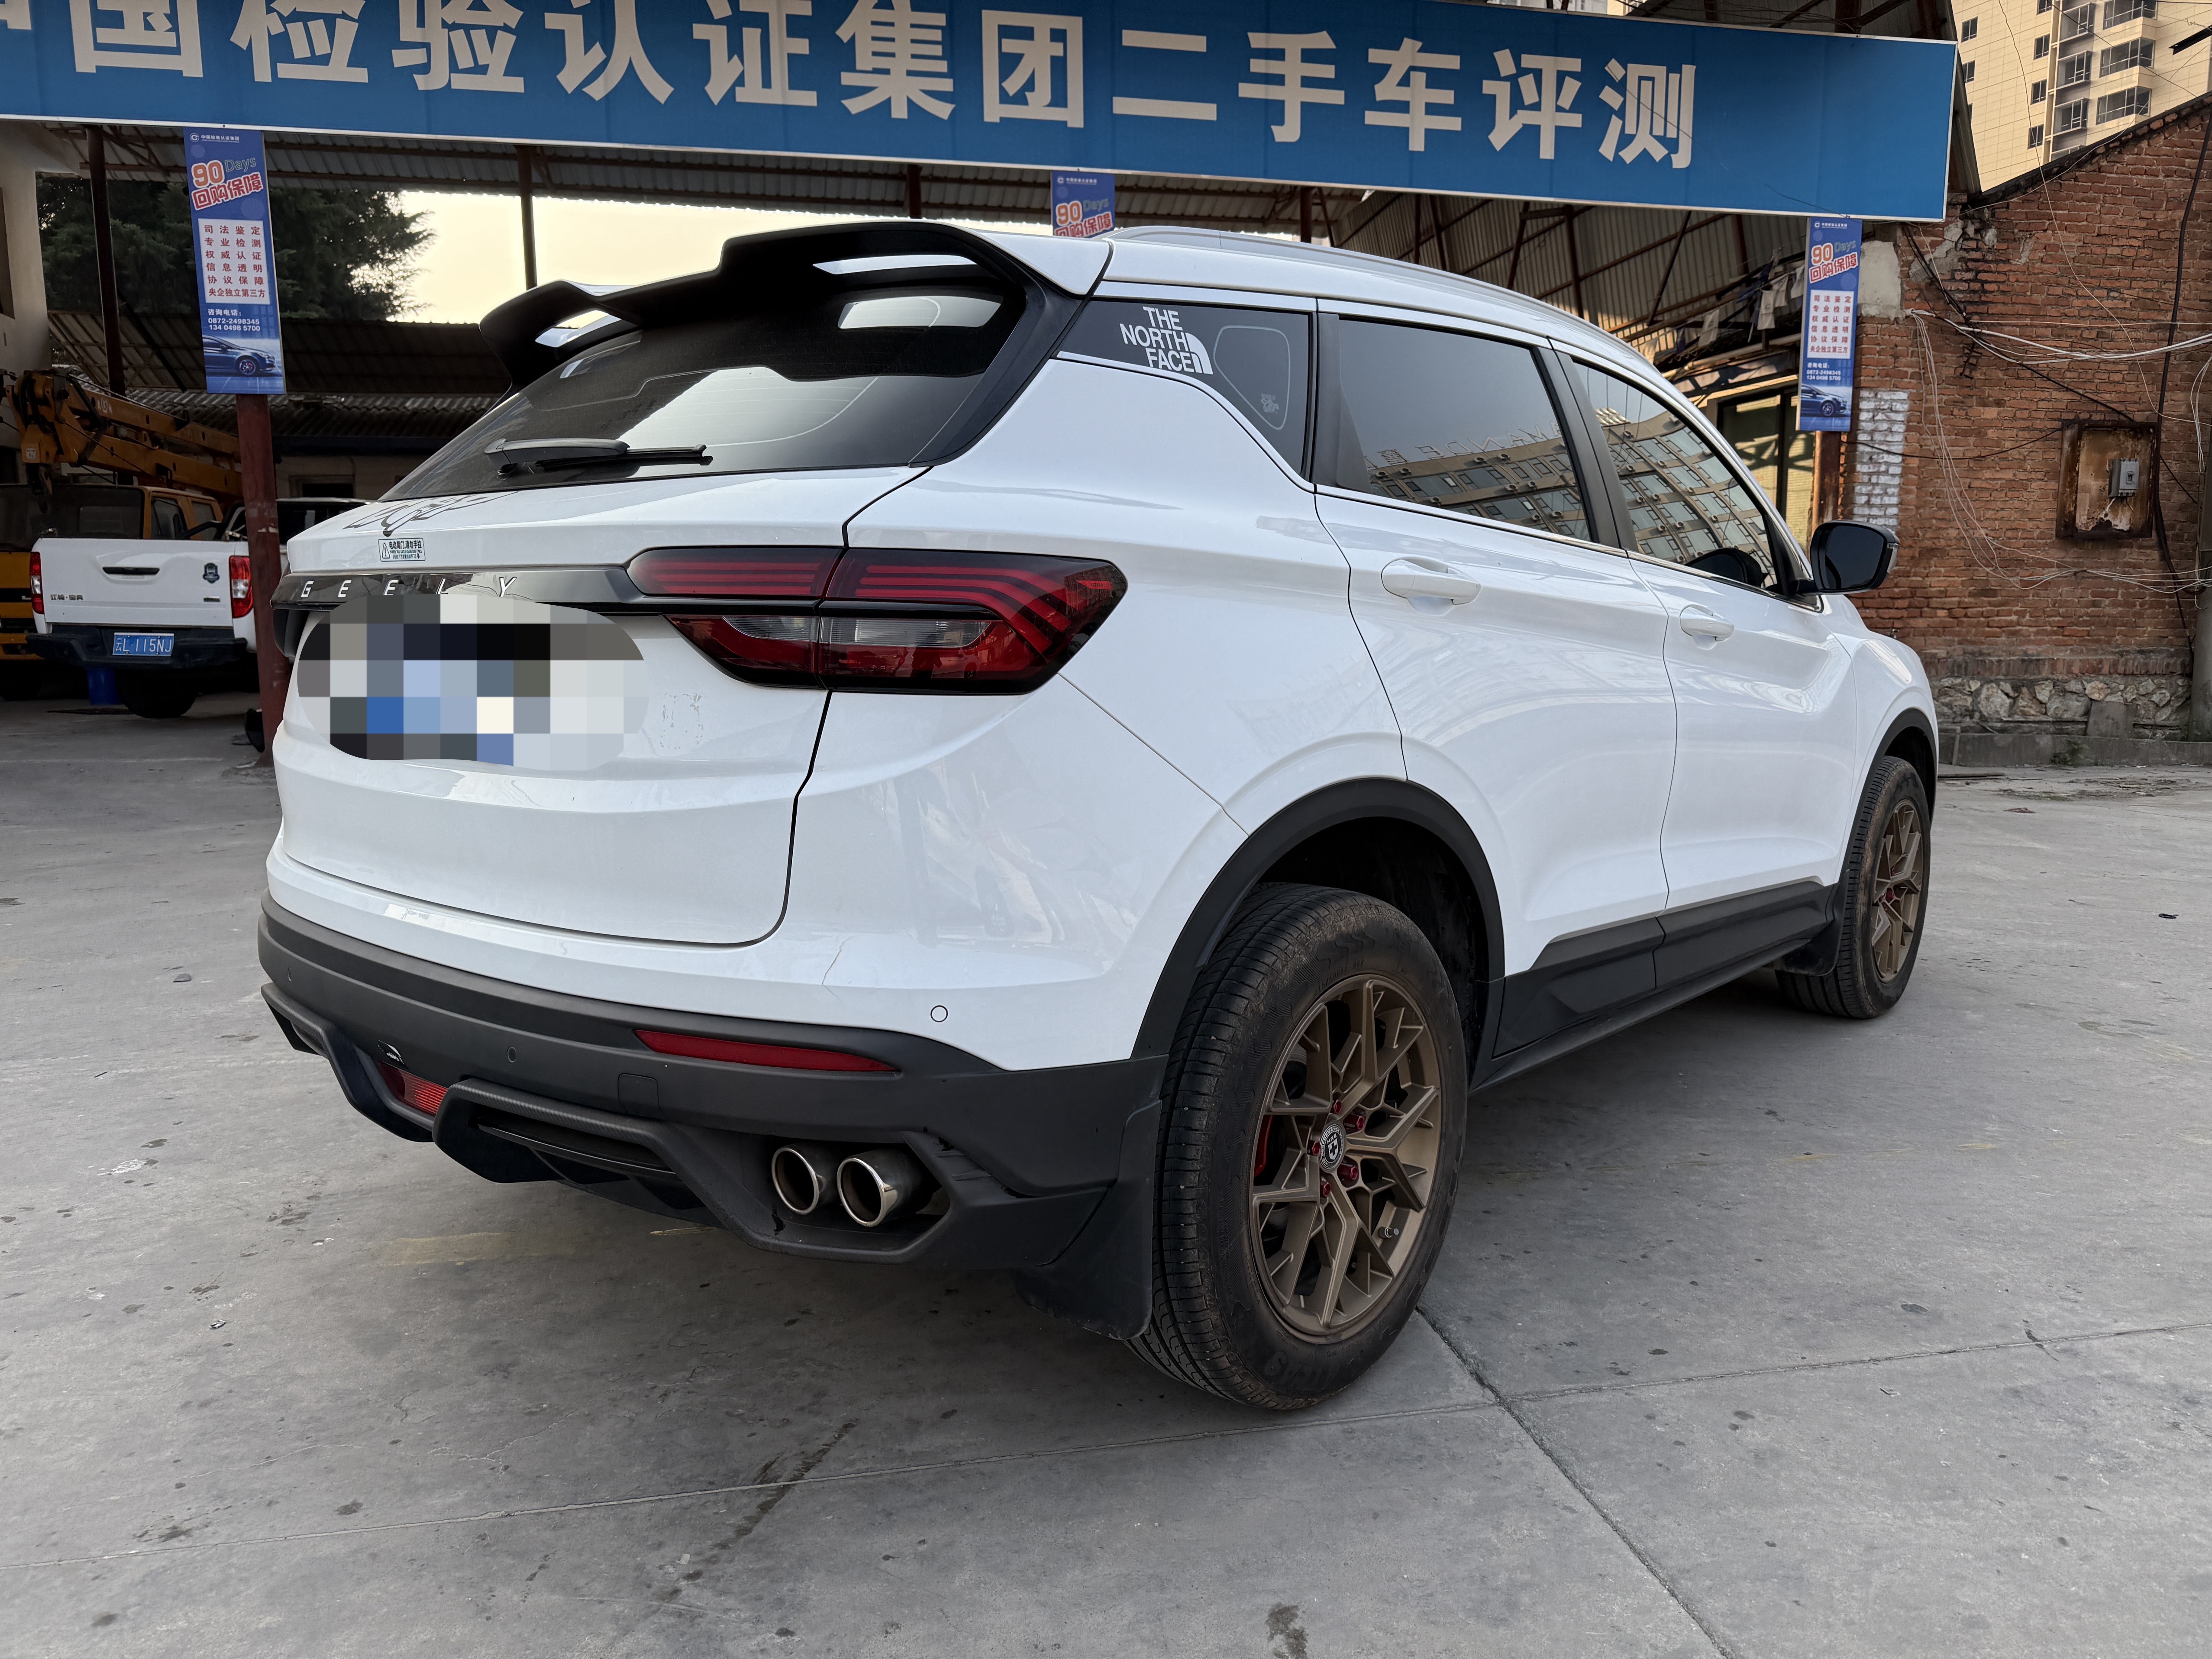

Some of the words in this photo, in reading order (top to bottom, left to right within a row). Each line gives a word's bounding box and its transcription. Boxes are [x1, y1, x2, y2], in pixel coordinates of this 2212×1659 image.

[0, 0, 1696, 168] 国检验认证集团二手车评测
[192, 160, 224, 187] 90
[225, 158, 256, 172] Days
[191, 172, 263, 210] 回购保障
[1056, 200, 1082, 226] 90
[1082, 198, 1109, 212] Days
[204, 225, 261, 235] 司法鉴定
[204, 237, 261, 248] 专业检测
[205, 250, 262, 260] 权威认证
[1811, 242, 1833, 265] 90
[1834, 240, 1856, 252] Days
[206, 262, 262, 272] 信息透明
[1808, 252, 1858, 284] 回购保障
[207, 275, 264, 285] 协议保障
[208, 287, 266, 298] 央企独立第三方
[1143, 306, 1183, 331] THE
[1119, 323, 1190, 352] NORTH
[1145, 348, 1194, 373] FACE
[300, 577, 517, 598] GEELY
